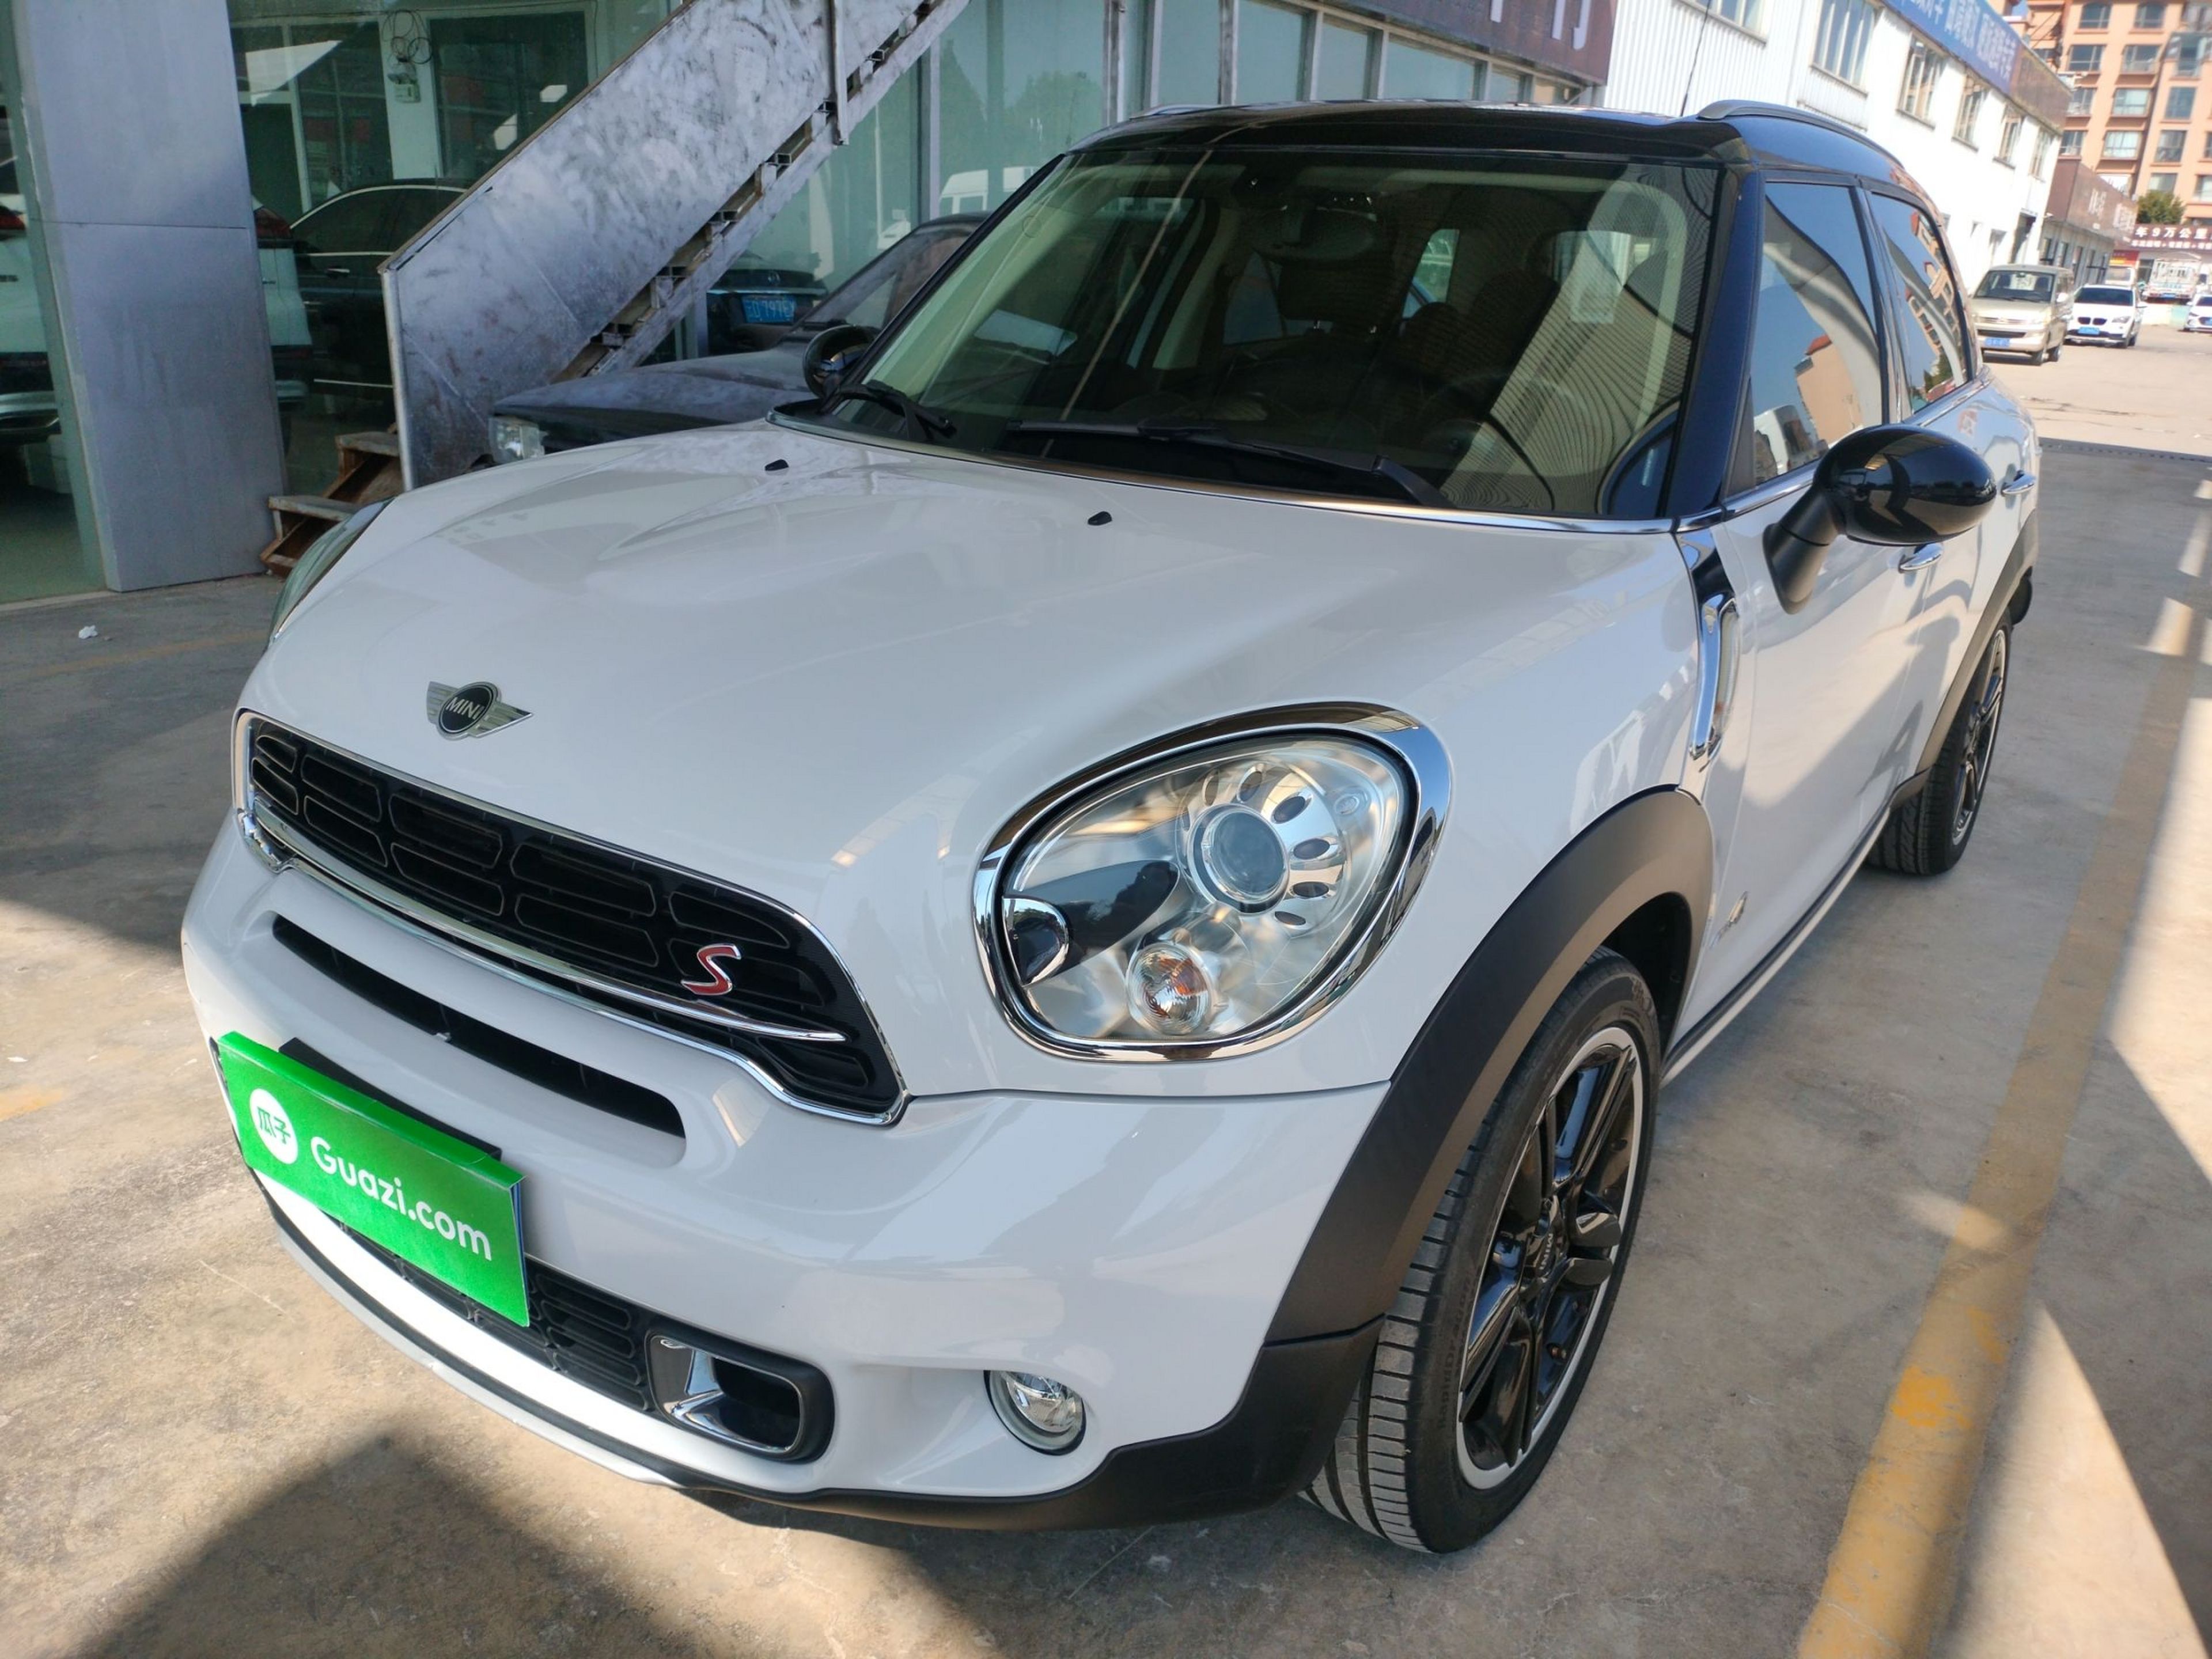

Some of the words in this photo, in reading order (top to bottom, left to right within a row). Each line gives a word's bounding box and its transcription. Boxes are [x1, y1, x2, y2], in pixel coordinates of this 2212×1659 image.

[2135, 226, 2212, 240] 年9万公里
[445, 696, 486, 721] MINI
[680, 943, 742, 996] S
[256, 1105, 291, 1145] 瓜子
[310, 1136, 492, 1262] Guazi.com
[1539, 1233, 1554, 1270] MINI
